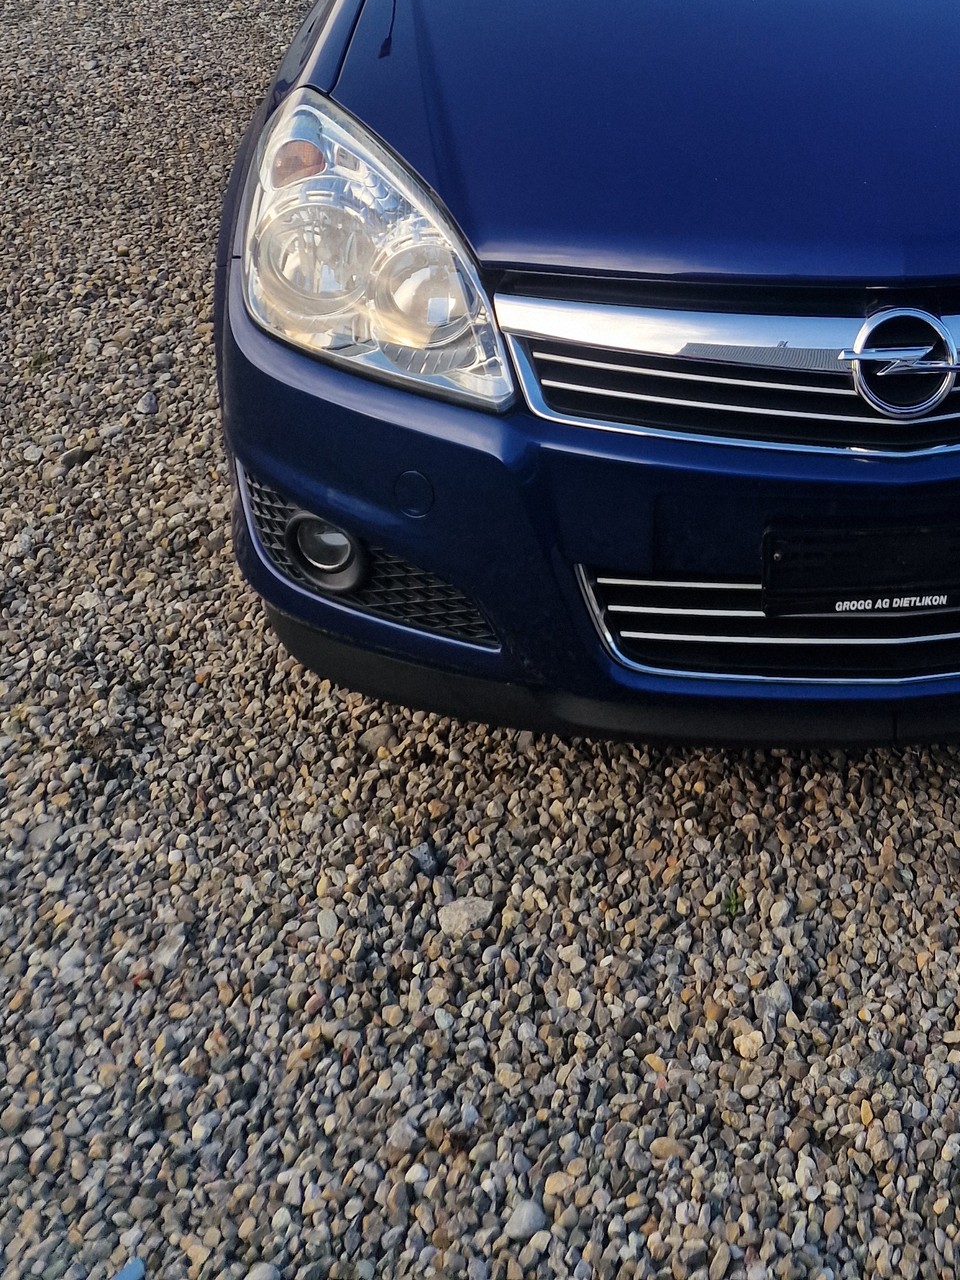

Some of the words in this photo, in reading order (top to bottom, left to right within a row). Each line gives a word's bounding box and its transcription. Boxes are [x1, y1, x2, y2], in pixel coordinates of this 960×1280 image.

[835, 600, 873, 612] GROGG
[874, 598, 890, 609] AG
[892, 595, 948, 608] DIETLIKON
